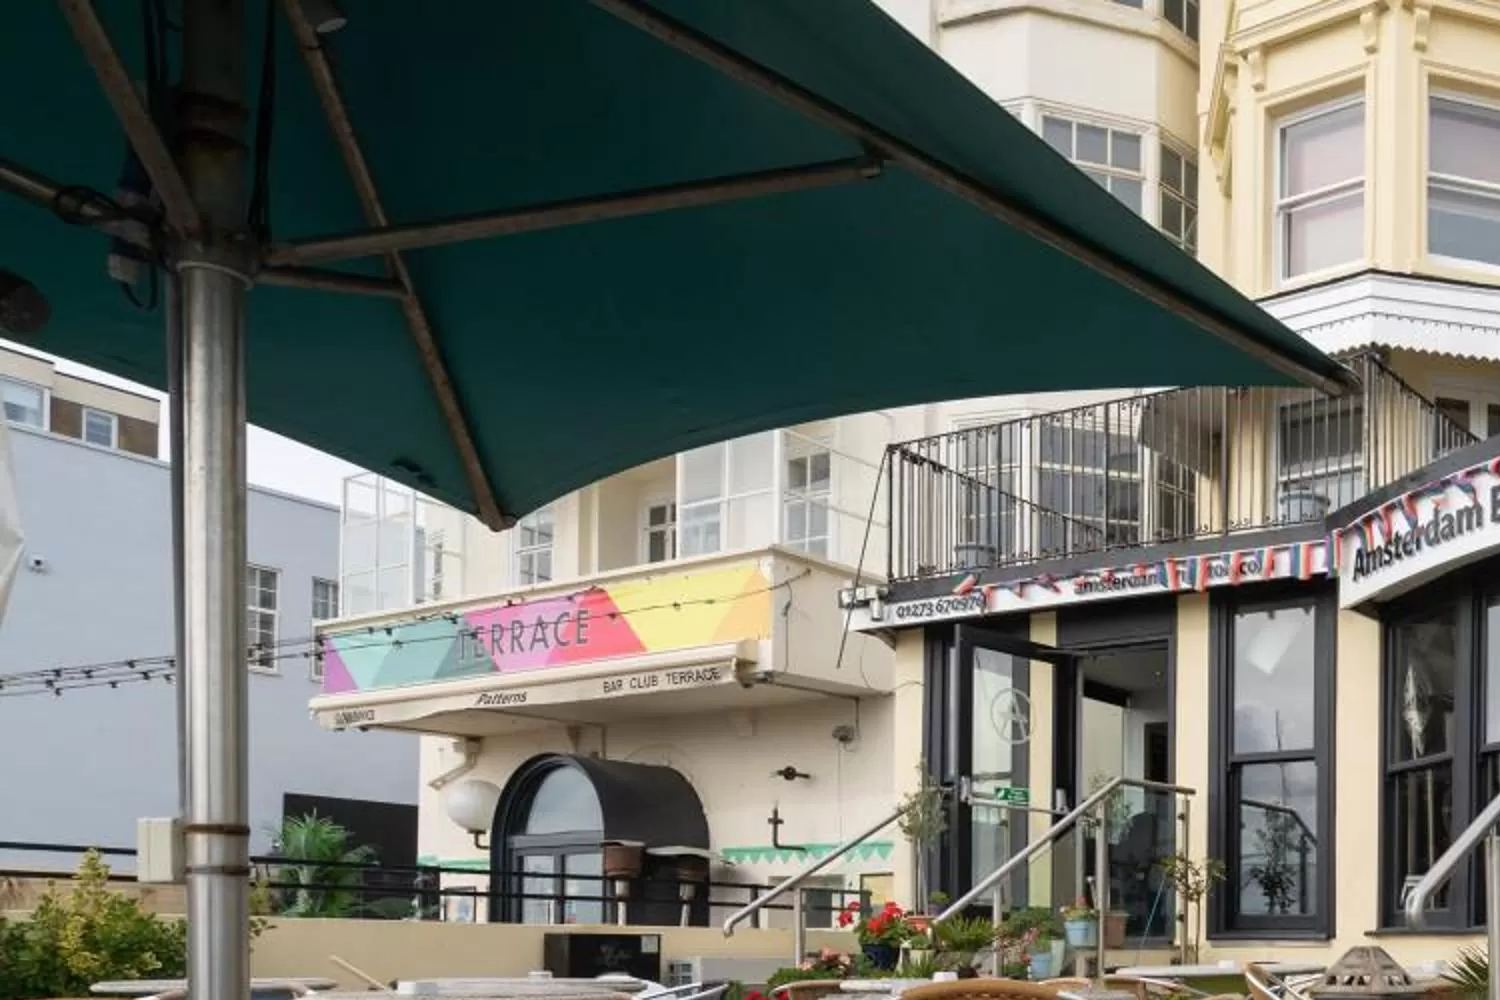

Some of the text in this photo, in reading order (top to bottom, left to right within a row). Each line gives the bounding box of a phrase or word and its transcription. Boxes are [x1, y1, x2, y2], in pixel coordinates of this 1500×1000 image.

[1353, 503, 1484, 582] Amsterdam
[457, 609, 590, 660] TERRACE
[475, 691, 528, 705] Patterns
[603, 668, 720, 693] BAR CLUB TERRACE
